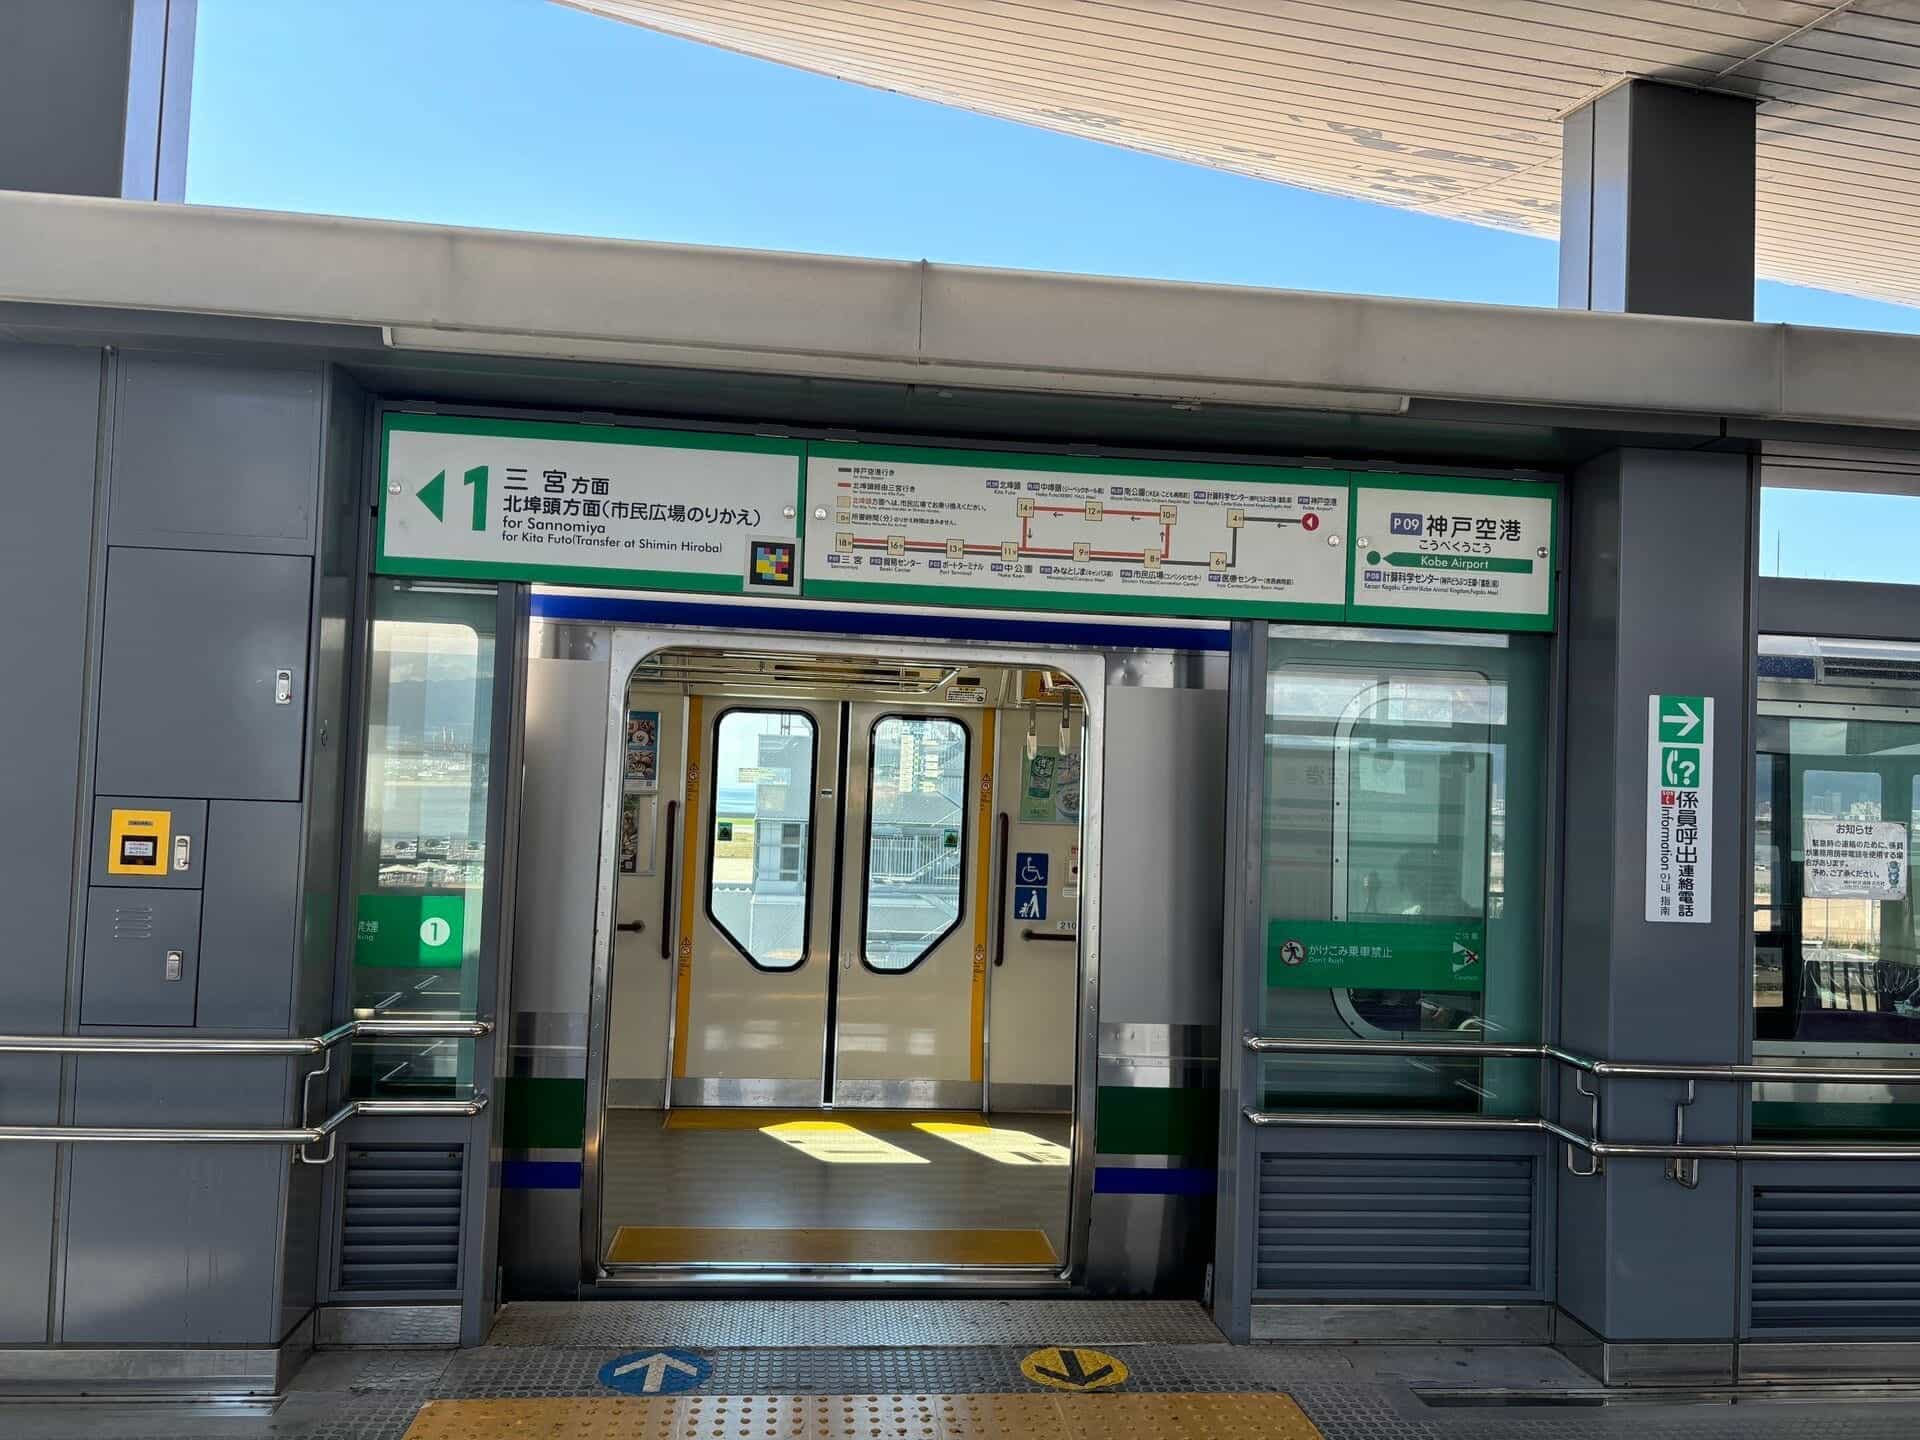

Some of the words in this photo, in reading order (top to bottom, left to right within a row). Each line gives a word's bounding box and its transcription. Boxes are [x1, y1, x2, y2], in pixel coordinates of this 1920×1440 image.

[463, 465, 490, 531] 1
[502, 516, 523, 529] for
[527, 517, 606, 536] Sannomiya
[1426, 514, 1521, 541] 神戸空港
[502, 531, 519, 541] for
[521, 532, 544, 543] Kita
[624, 538, 636, 548] at
[639, 538, 677, 551] Shimin
[1419, 539, 1492, 554] こうべくうこう
[1004, 564, 1033, 574] 中公
[1421, 555, 1448, 567] Kobe
[1451, 558, 1489, 570] Airport
[1660, 806, 1673, 870] Information
[1836, 824, 1873, 835] お知らせ
